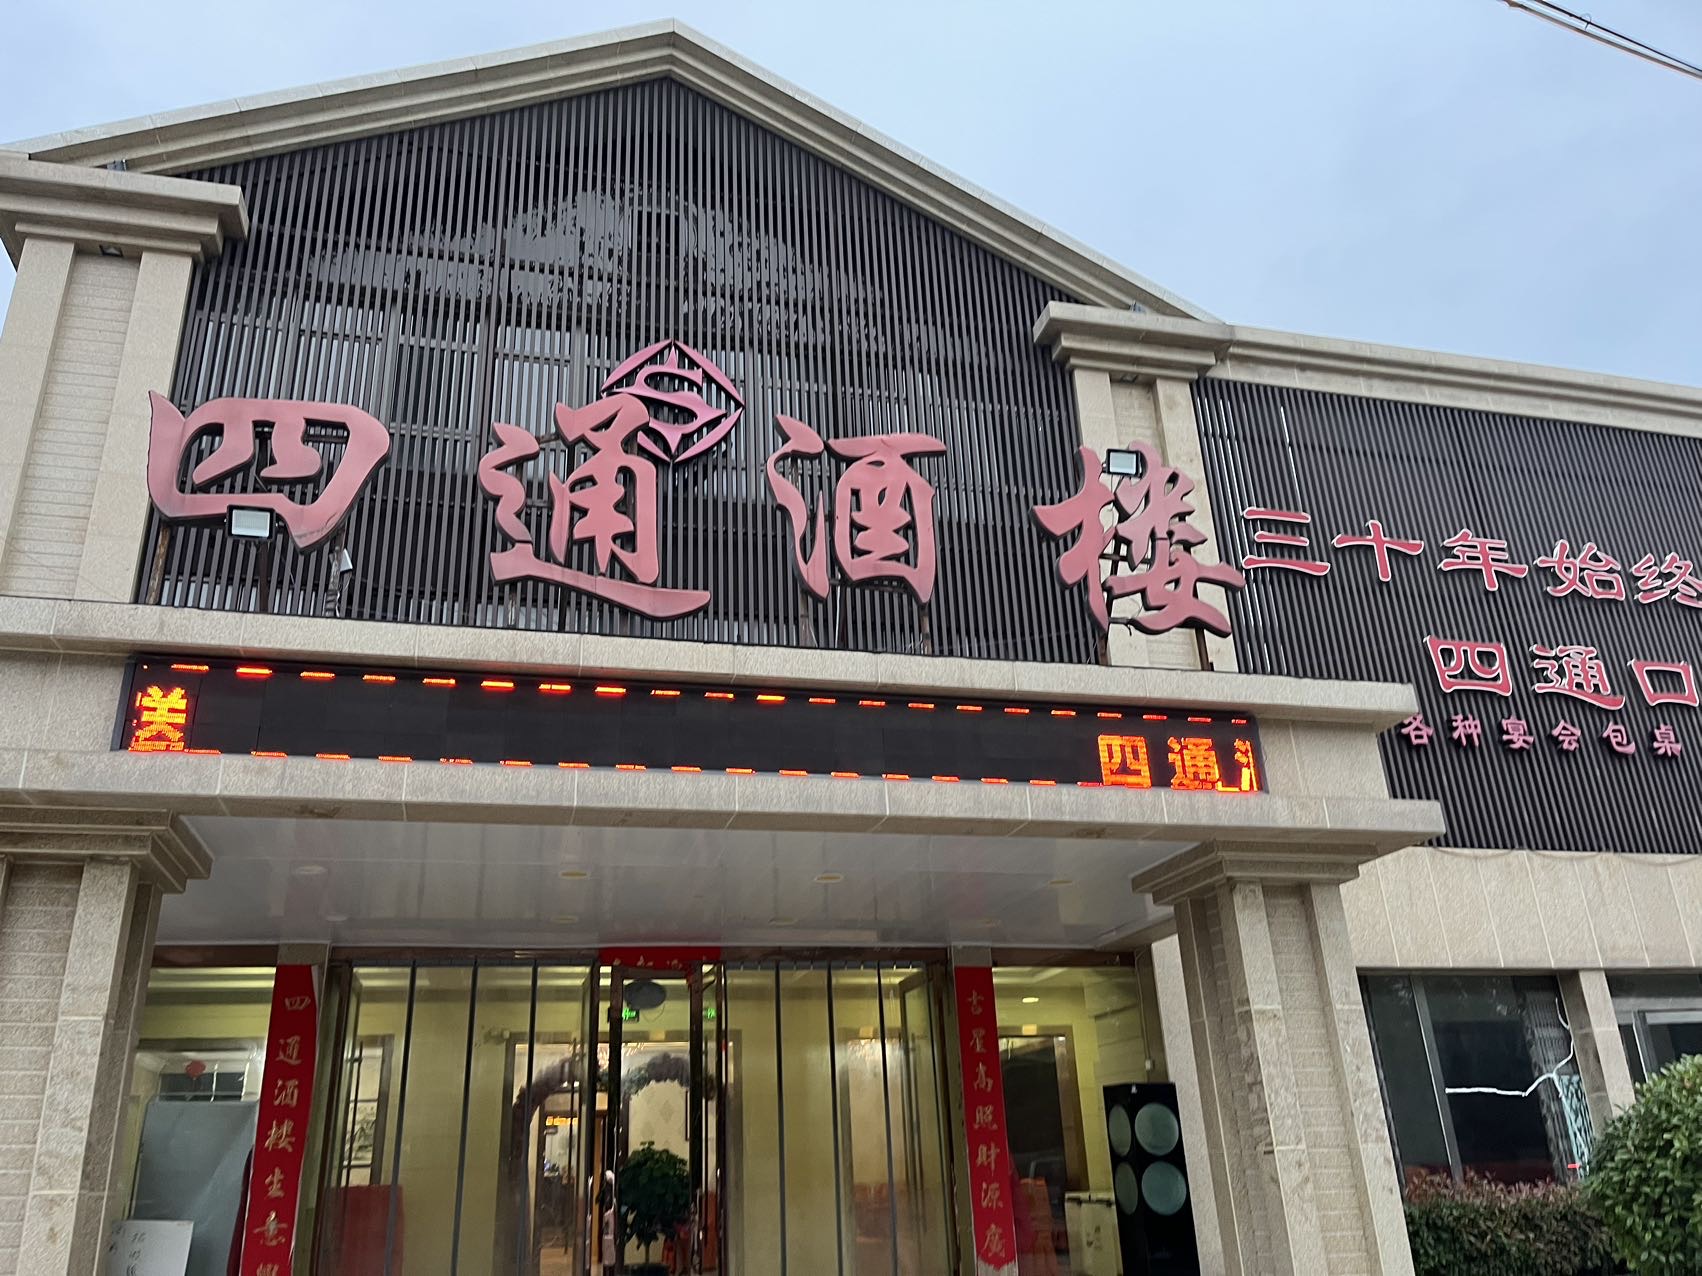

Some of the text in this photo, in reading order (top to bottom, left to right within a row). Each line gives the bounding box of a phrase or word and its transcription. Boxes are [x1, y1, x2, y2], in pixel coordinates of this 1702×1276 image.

[148, 390, 1246, 638] 四通酒楼
[1241, 505, 1702, 608] 三十年始终
[1424, 635, 1700, 710] 四通口
[1400, 712, 1682, 758] 各种宴会包桌
